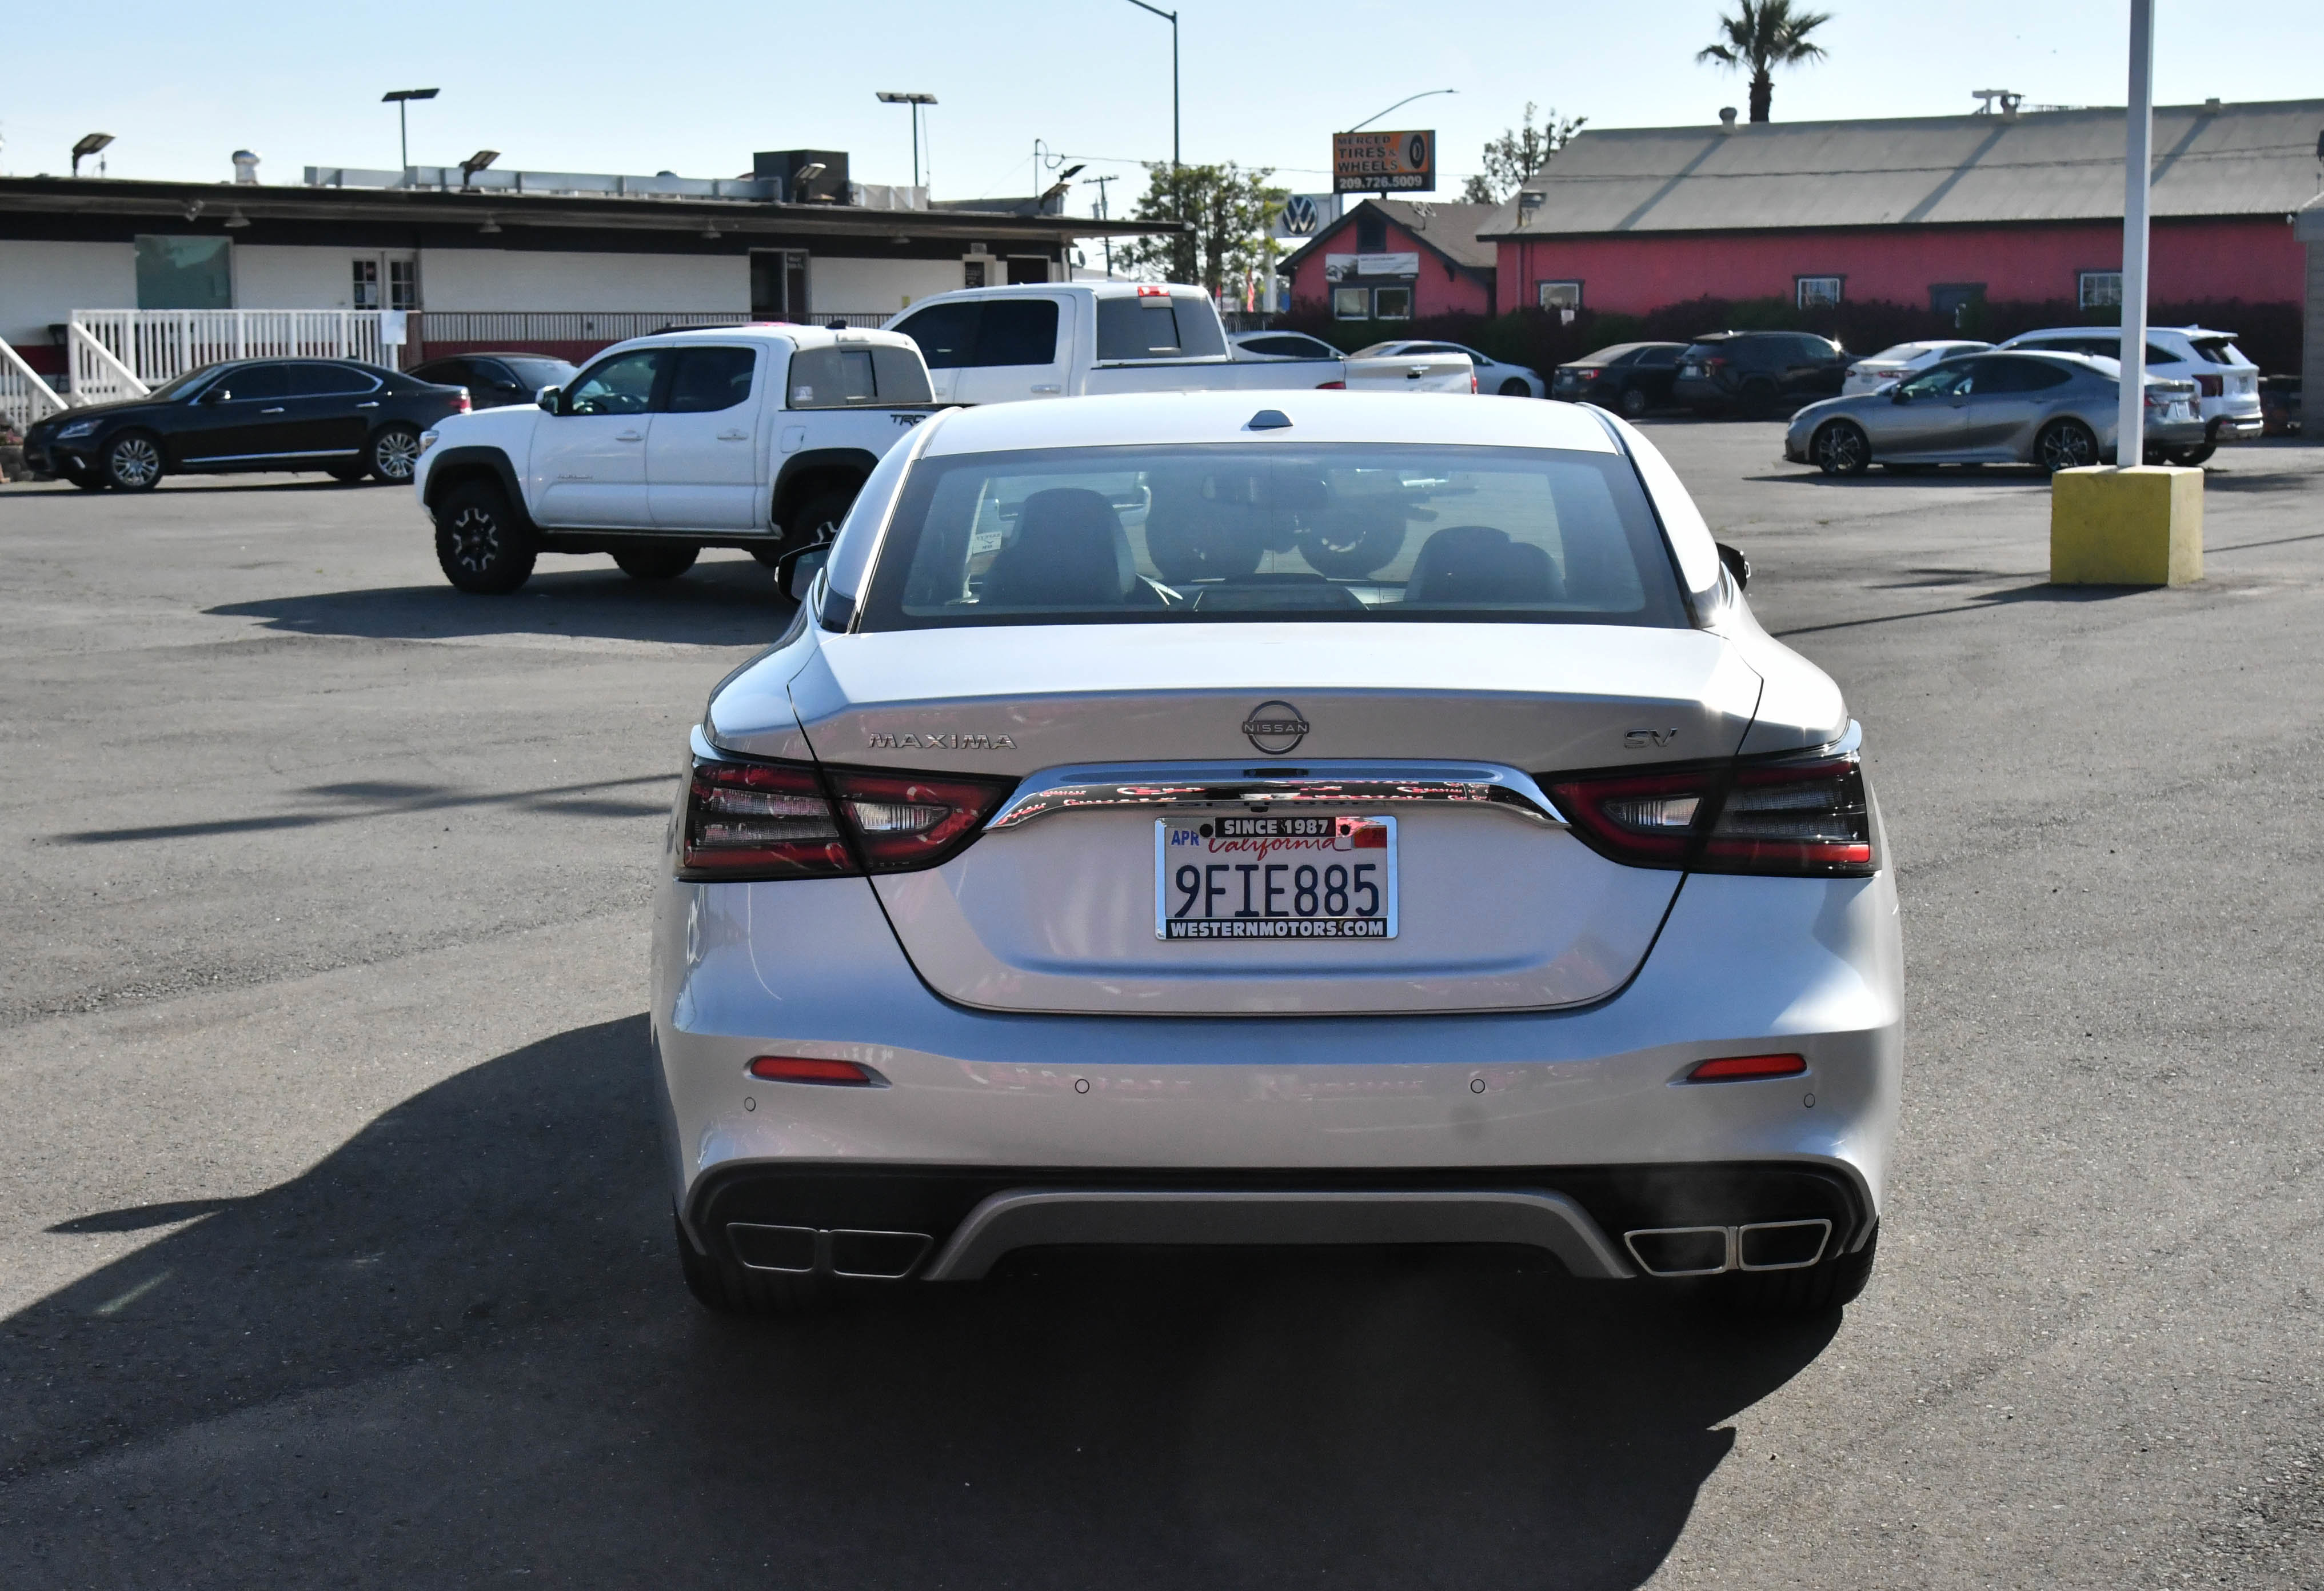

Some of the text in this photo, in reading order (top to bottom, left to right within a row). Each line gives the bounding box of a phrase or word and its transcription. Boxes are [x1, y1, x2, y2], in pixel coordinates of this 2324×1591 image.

[1337, 135, 1391, 145] MERCED
[1339, 147, 1385, 158] TIRES
[1338, 160, 1398, 172] WHEELS
[1339, 175, 1422, 189] 209.726.5009
[1244, 724, 1307, 732] NISSAN
[866, 733, 1017, 749] MAXIMA
[1624, 727, 1678, 749] SV
[1224, 820, 1328, 835] SINCE 1987
[1172, 830, 1200, 846] APR
[1208, 838, 1352, 861] California
[1174, 864, 1379, 917] 9FIE885
[1171, 920, 1383, 937] WESTERNMOTORS.COM
